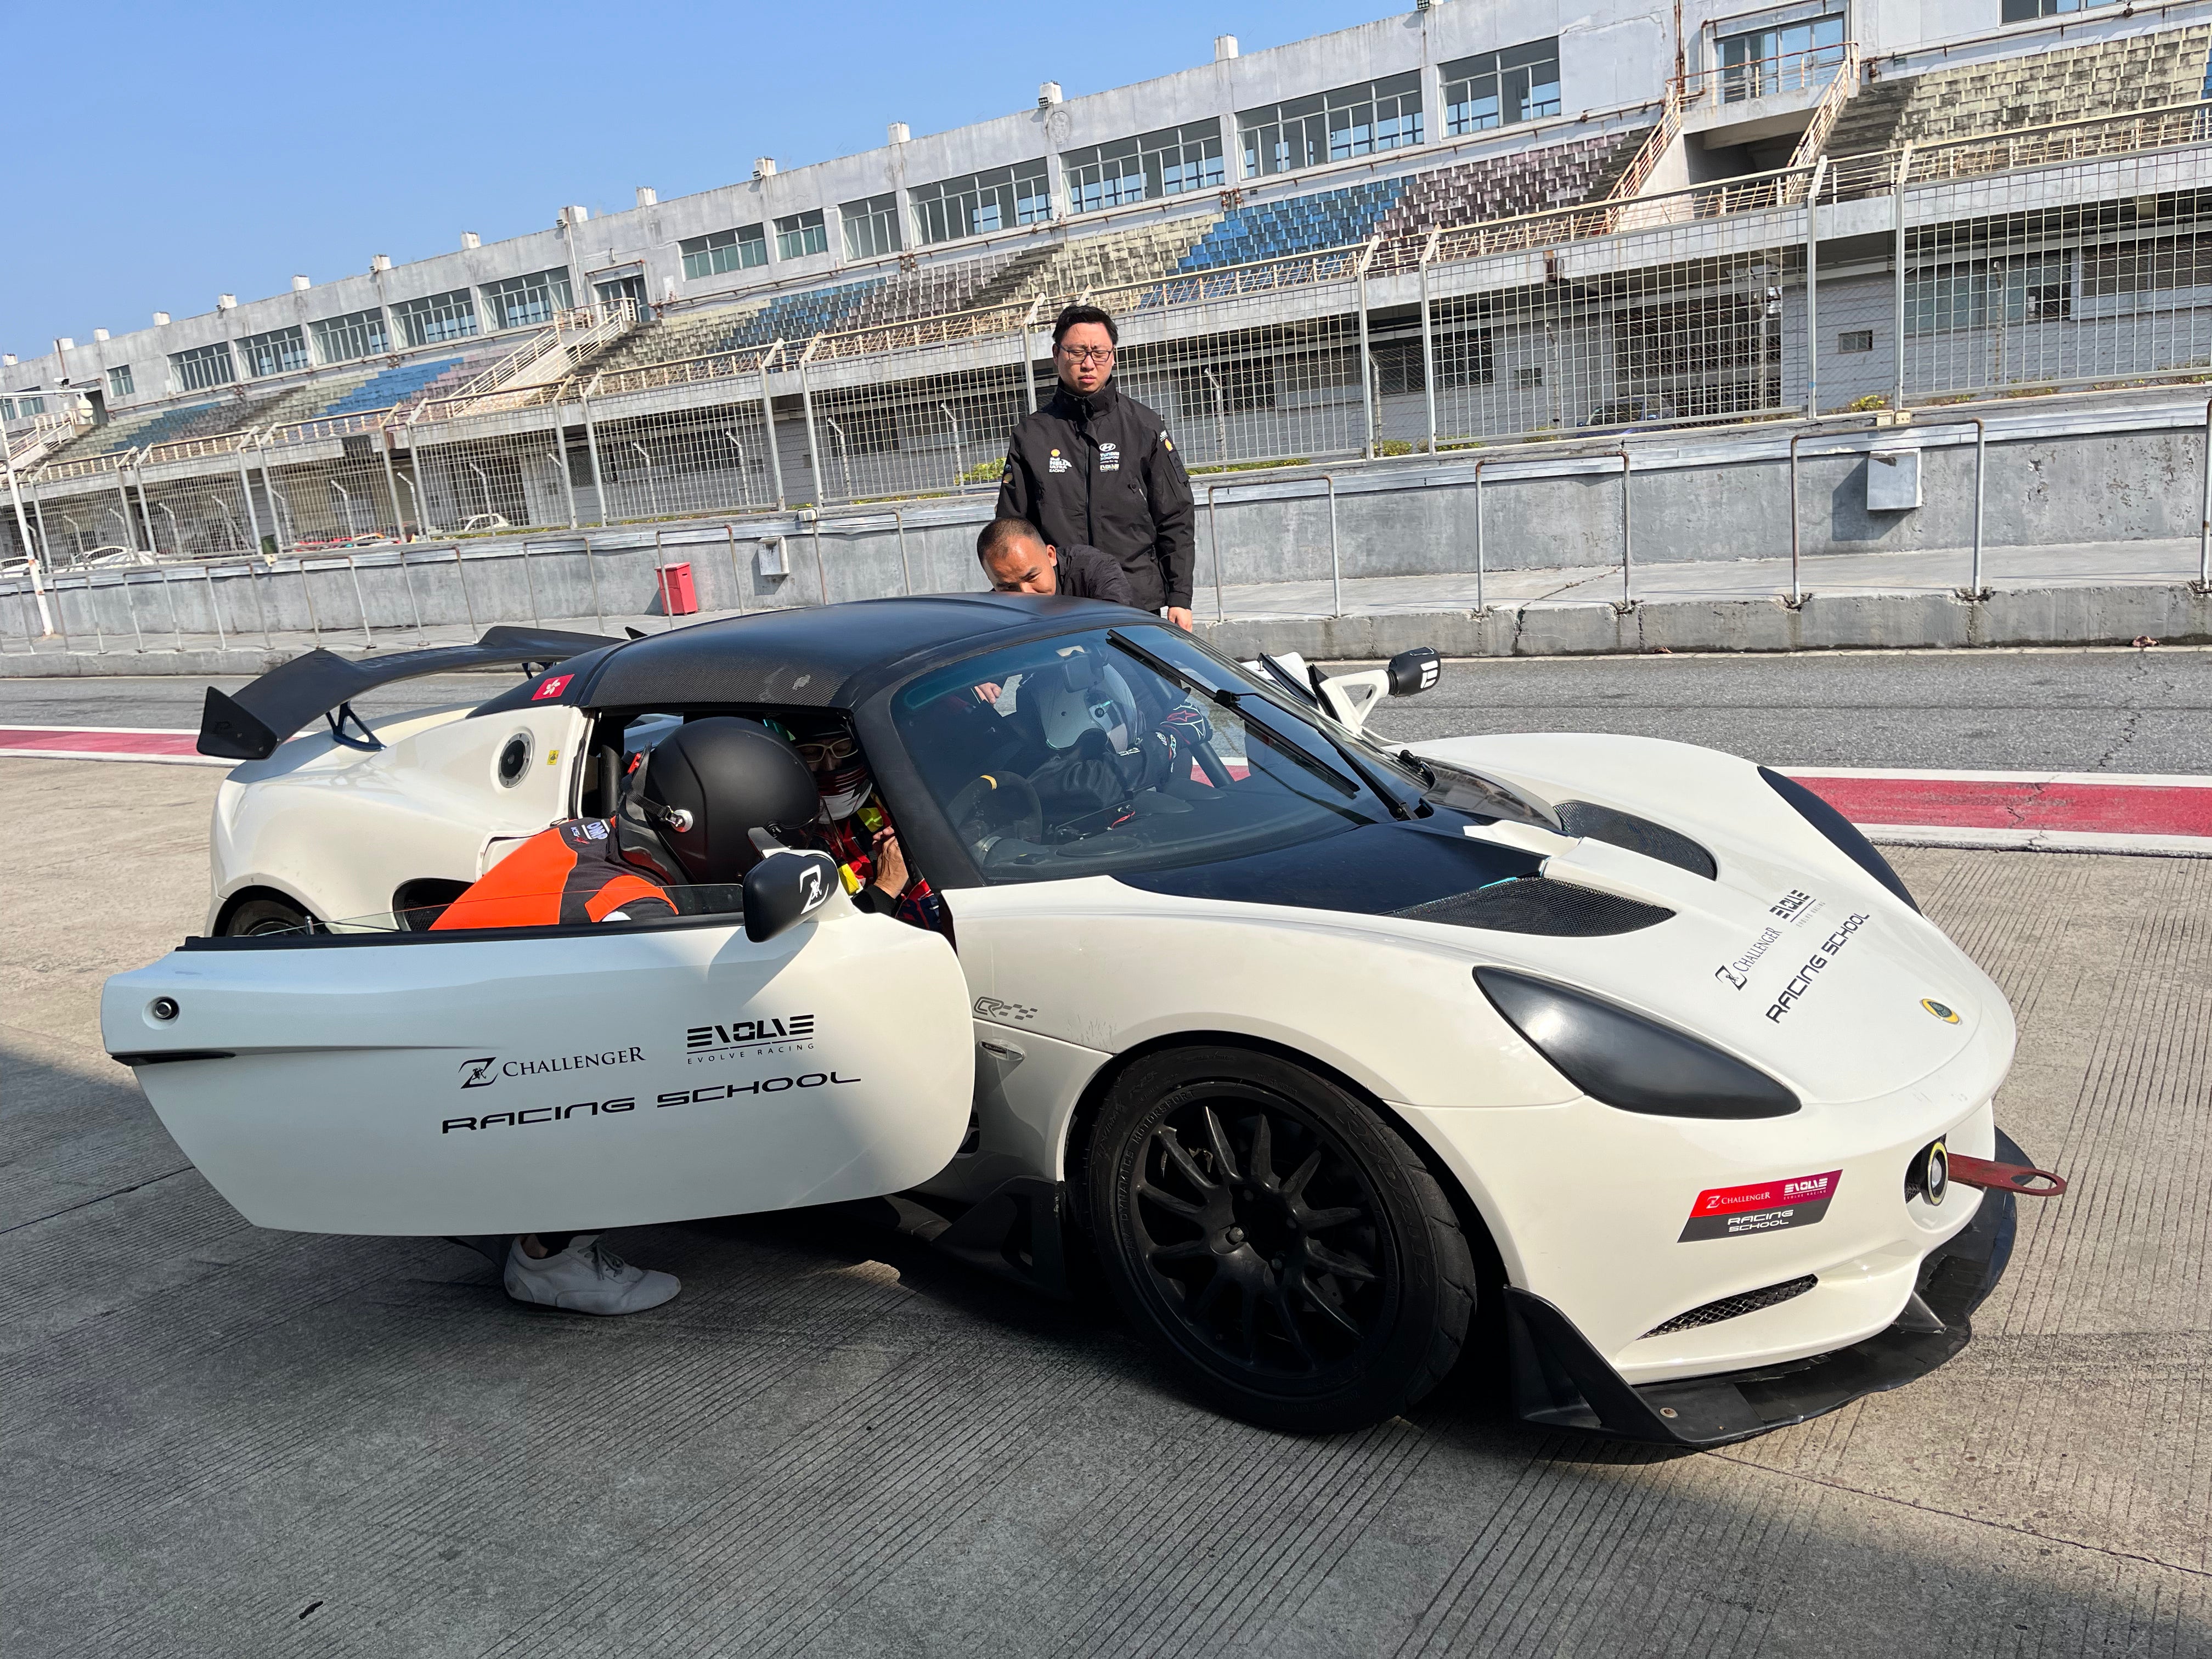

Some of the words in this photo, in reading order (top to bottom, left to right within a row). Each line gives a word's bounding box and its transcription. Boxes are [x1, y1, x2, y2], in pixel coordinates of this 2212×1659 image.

[586, 822, 608, 840] OMP
[1769, 889, 1811, 919] EVOLVE
[1733, 927, 1782, 972] CHALLENGER
[1765, 954, 1827, 1024] RACING
[1821, 912, 1870, 956] SCHOOL
[687, 1014, 814, 1048] EVOLVE
[503, 1046, 646, 1077] CHALLENGER
[687, 1052, 745, 1064] EVOLVE
[757, 1043, 814, 1055] RACING
[442, 1097, 635, 1134] RACING
[657, 1071, 861, 1108] SCHOOL
[1132, 1088, 1195, 1146] MOTORSPORT
[1721, 1192, 1771, 1205] CHALLENGER
[1784, 1178, 1828, 1193] EVOLVE
[1728, 1209, 1794, 1226] RACING
[1728, 1220, 1790, 1233] SCHOOL
